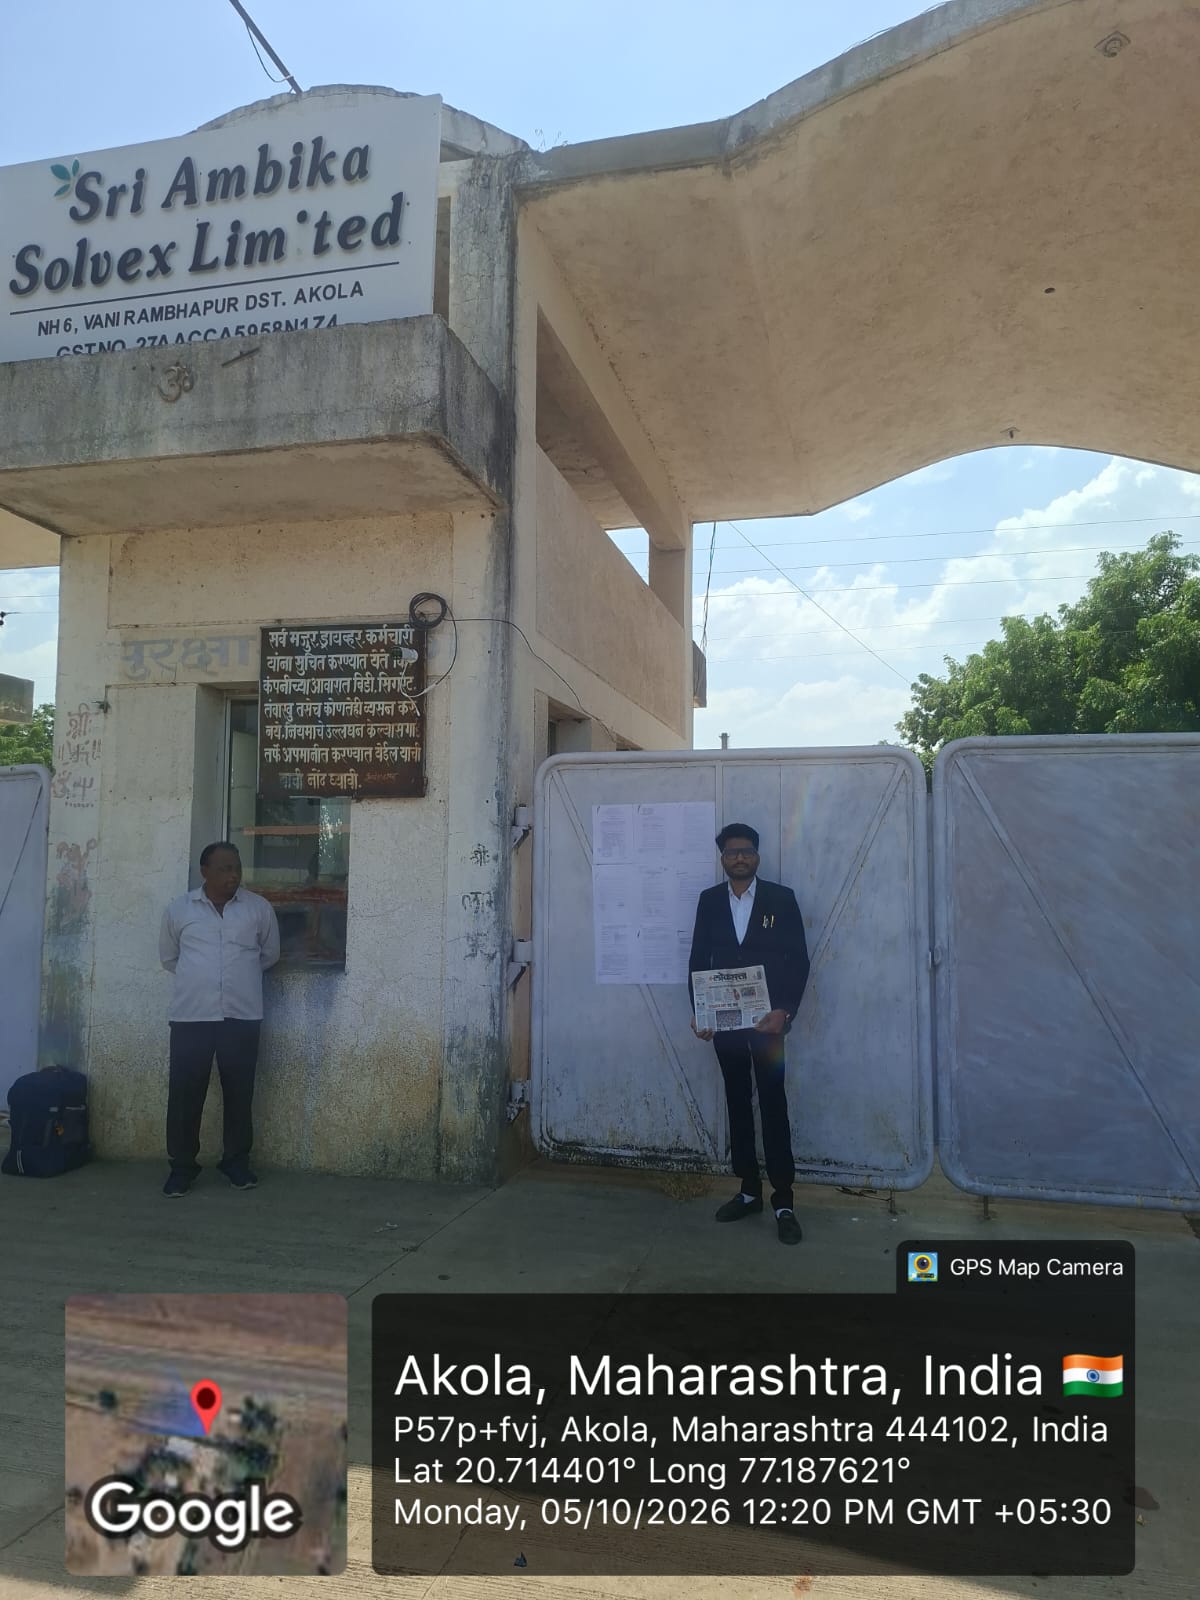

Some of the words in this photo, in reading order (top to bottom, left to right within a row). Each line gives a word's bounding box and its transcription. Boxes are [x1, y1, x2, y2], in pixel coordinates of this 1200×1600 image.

[69, 168, 146, 223] Sri
[161, 136, 370, 209] Ambika
[9, 238, 176, 296] Solvex
[188, 191, 405, 273] Limted
[38, 319, 60, 336] NH
[63, 317, 78, 335] 6,
[245, 291, 287, 311] DST.
[294, 281, 364, 304] AKOLA
[269, 628, 288, 648] सर्व
